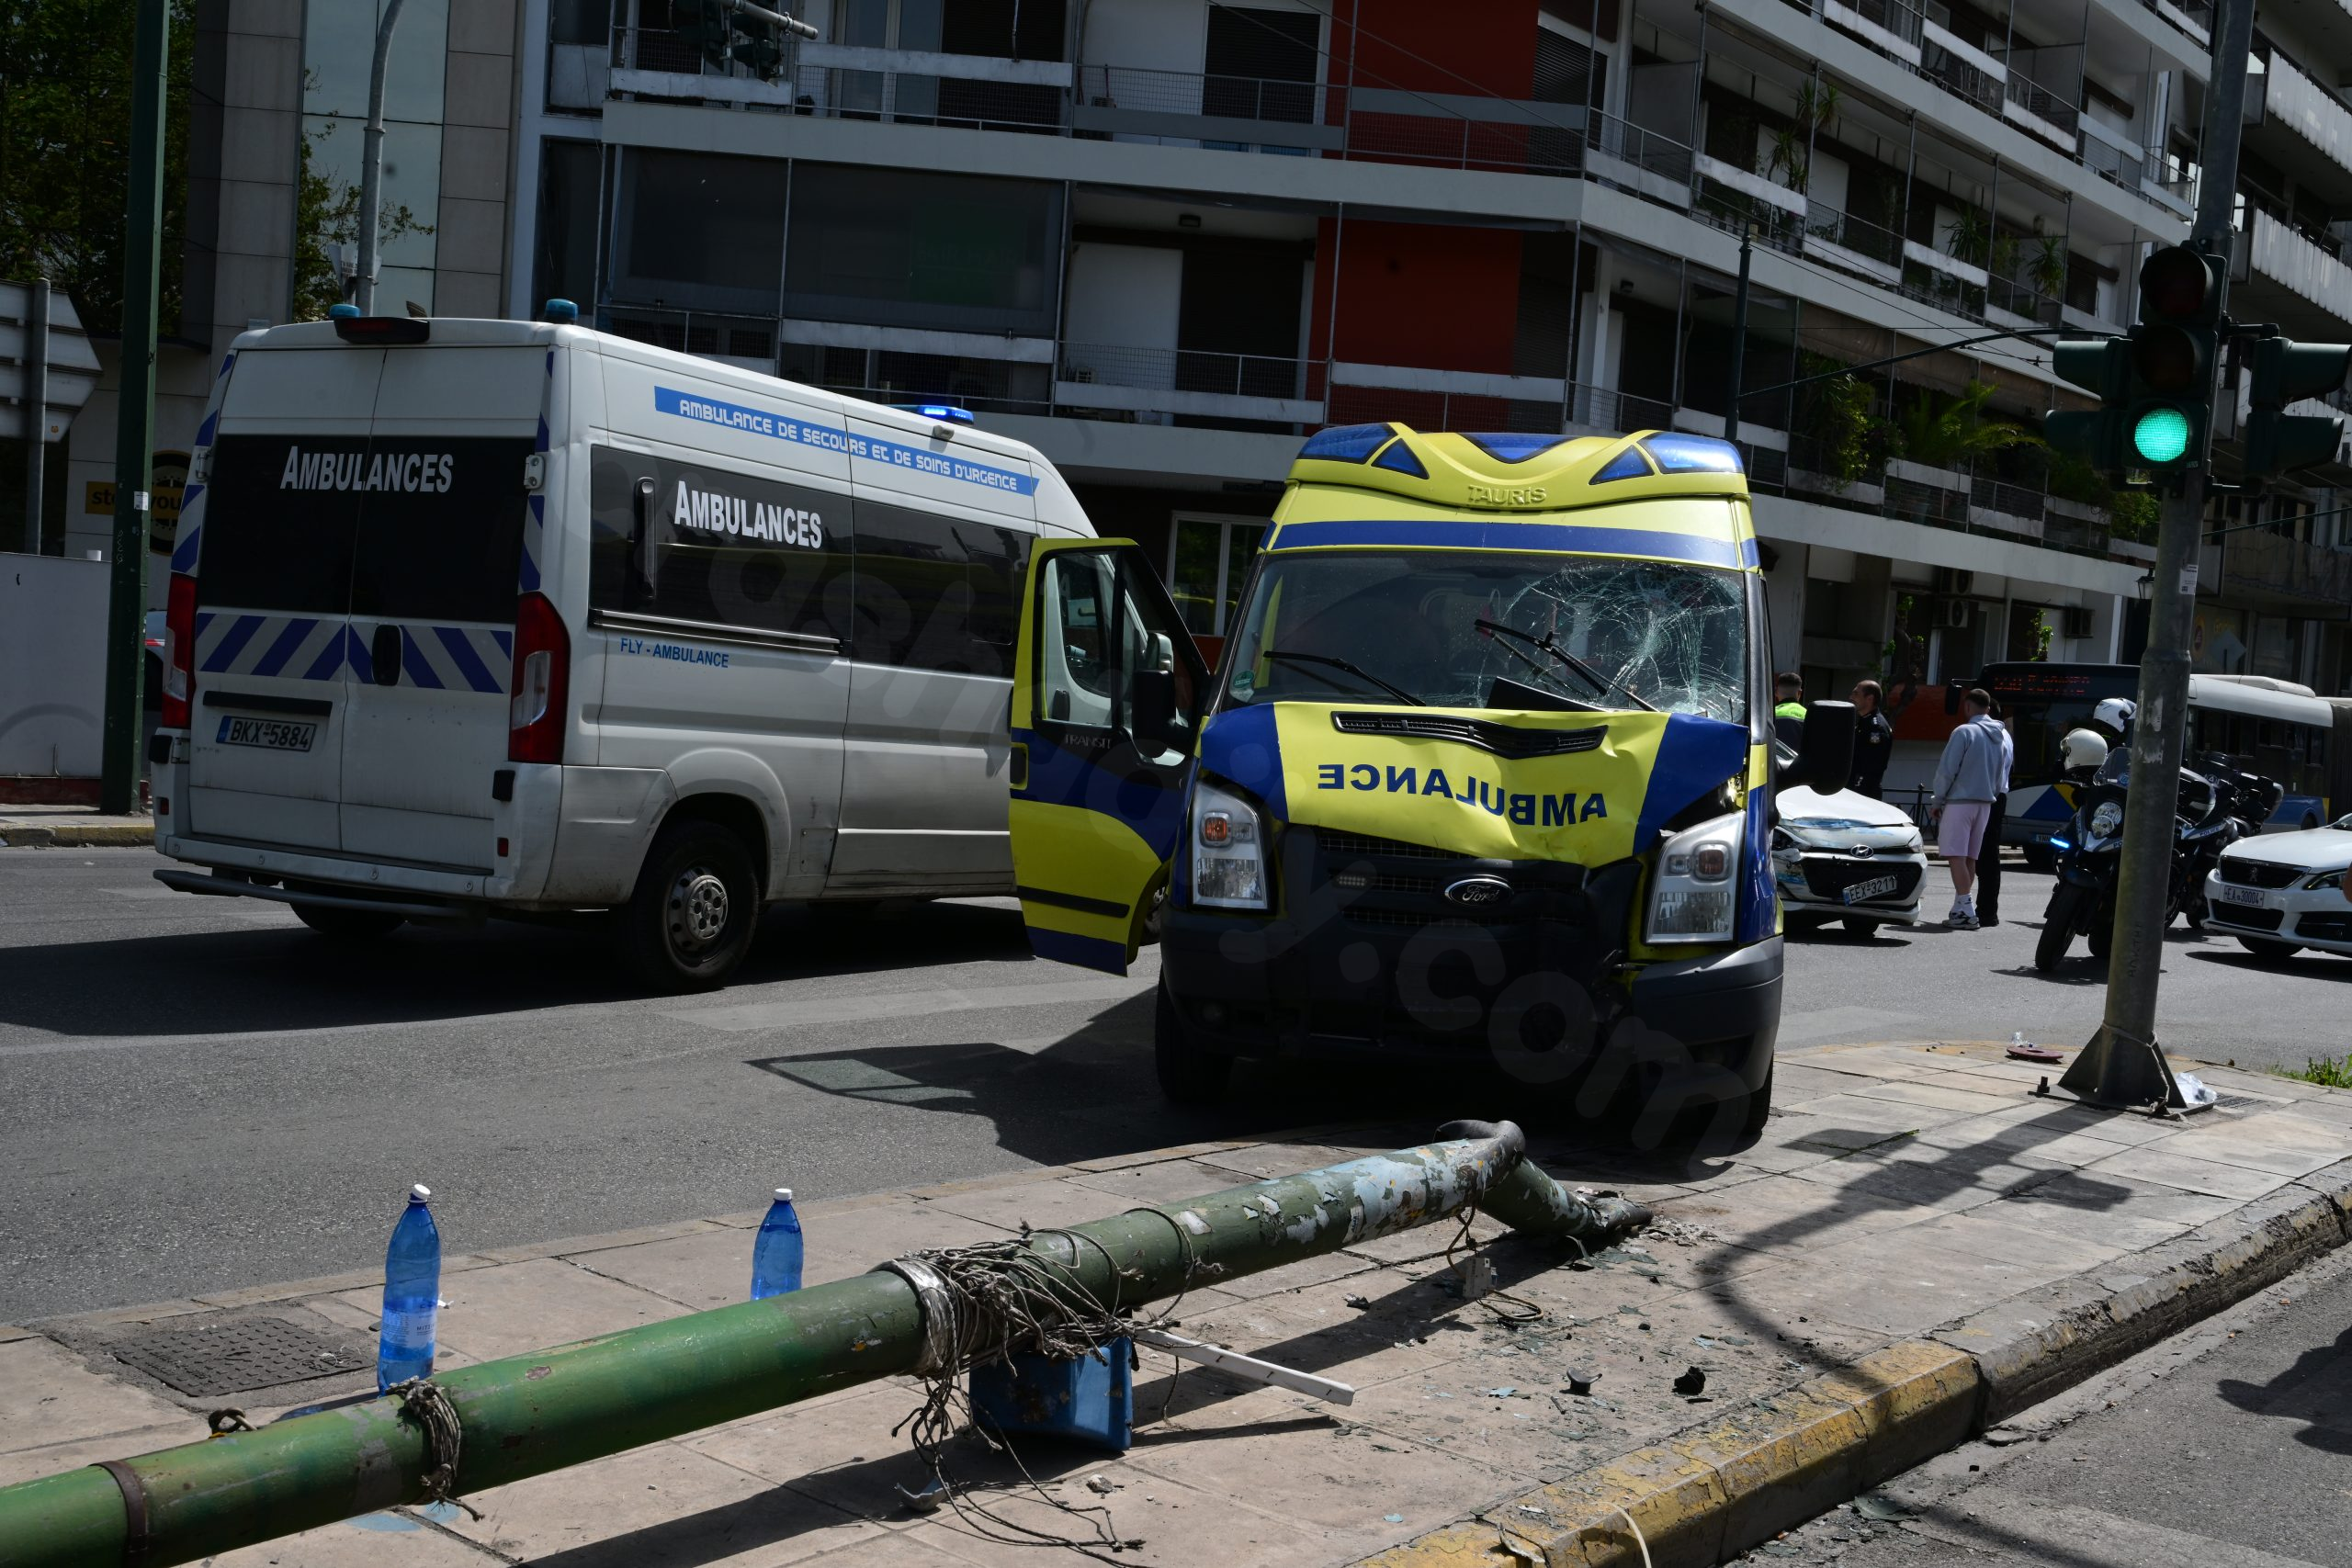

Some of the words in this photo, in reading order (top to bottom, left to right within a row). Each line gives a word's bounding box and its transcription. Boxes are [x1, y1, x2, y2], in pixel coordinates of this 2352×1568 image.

[680, 399, 773, 435] AMBULANCE
[778, 422, 797, 441] DE
[802, 427, 867, 456] SECOURS
[871, 445, 890, 461] ET
[894, 451, 912, 468] DE
[916, 455, 951, 477] SOINS
[955, 464, 1018, 491] D'URGENCE
[279, 446, 454, 493] AMBULANCES
[673, 479, 822, 549] AMBULANCES
[621, 637, 643, 655] FLY
[652, 643, 729, 668] AMBULANCE
[1064, 734, 1113, 750] TRANSIT
[1462, 884, 1500, 902] Ford
